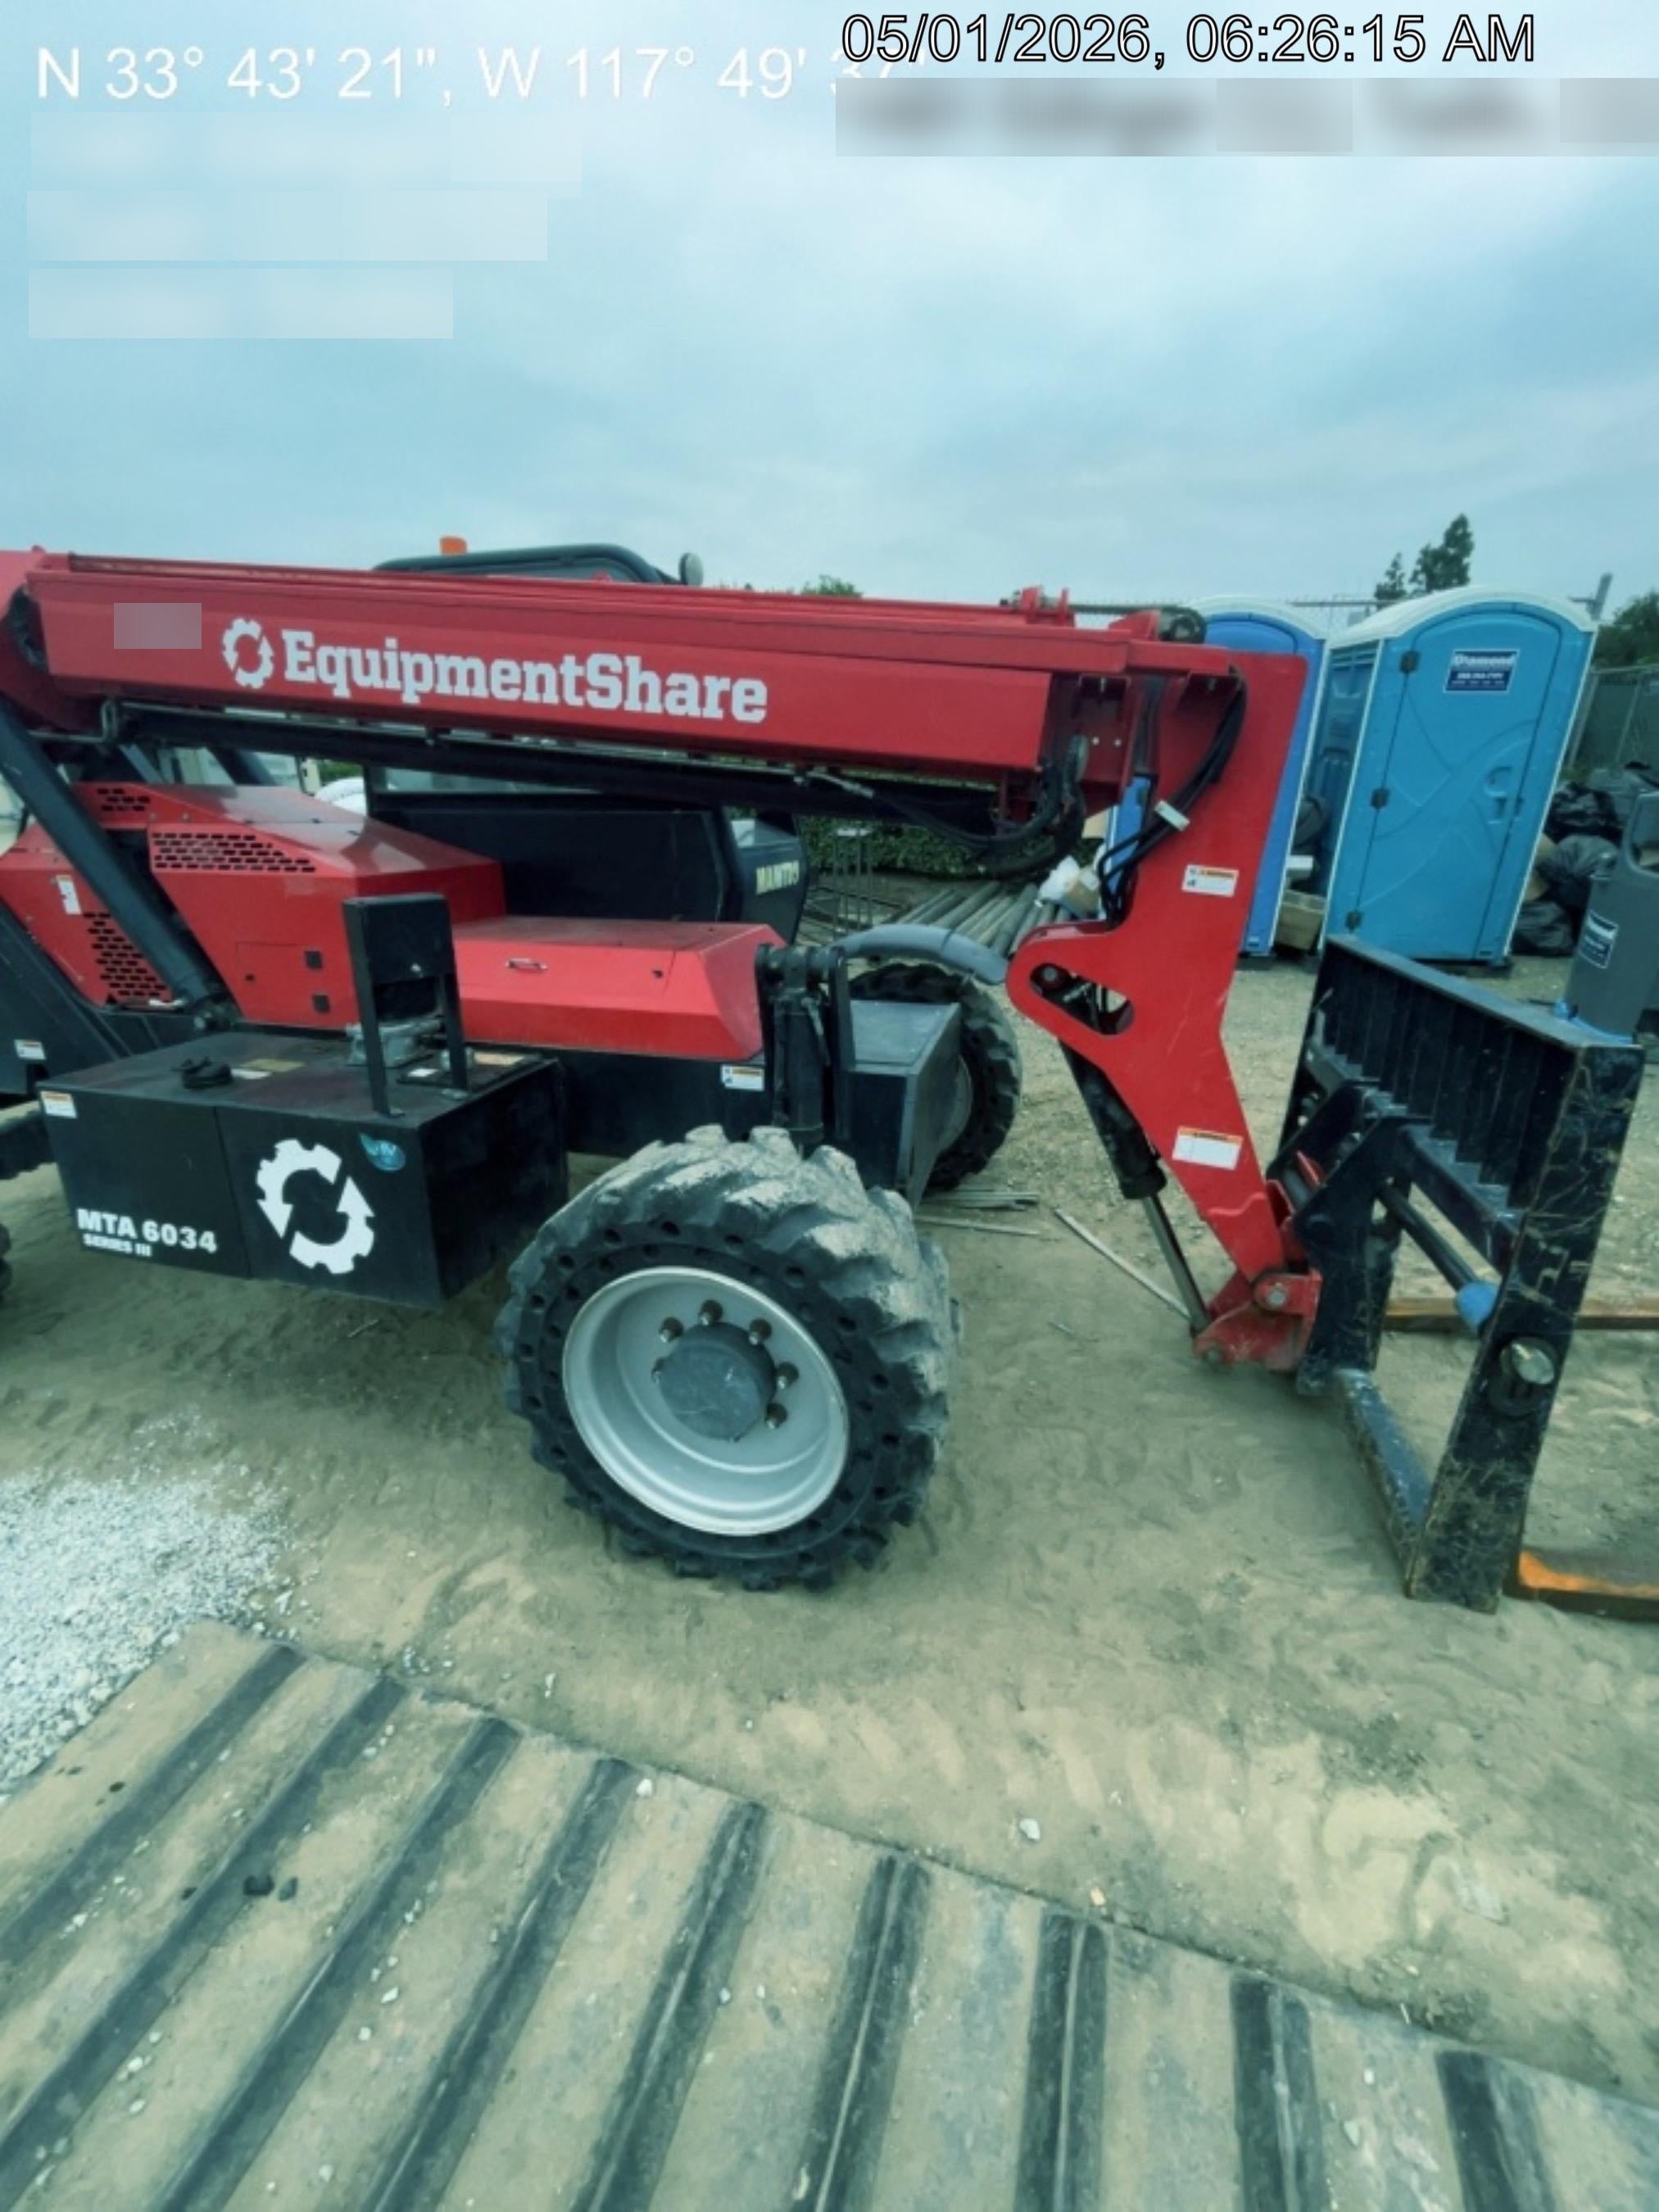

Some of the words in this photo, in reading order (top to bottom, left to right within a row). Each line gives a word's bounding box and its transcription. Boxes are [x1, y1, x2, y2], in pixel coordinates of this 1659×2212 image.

[281, 628, 768, 723] EquipmentShare
[77, 1208, 138, 1240] MTA
[142, 1219, 218, 1254] 6034
[134, 1243, 152, 1257] III
